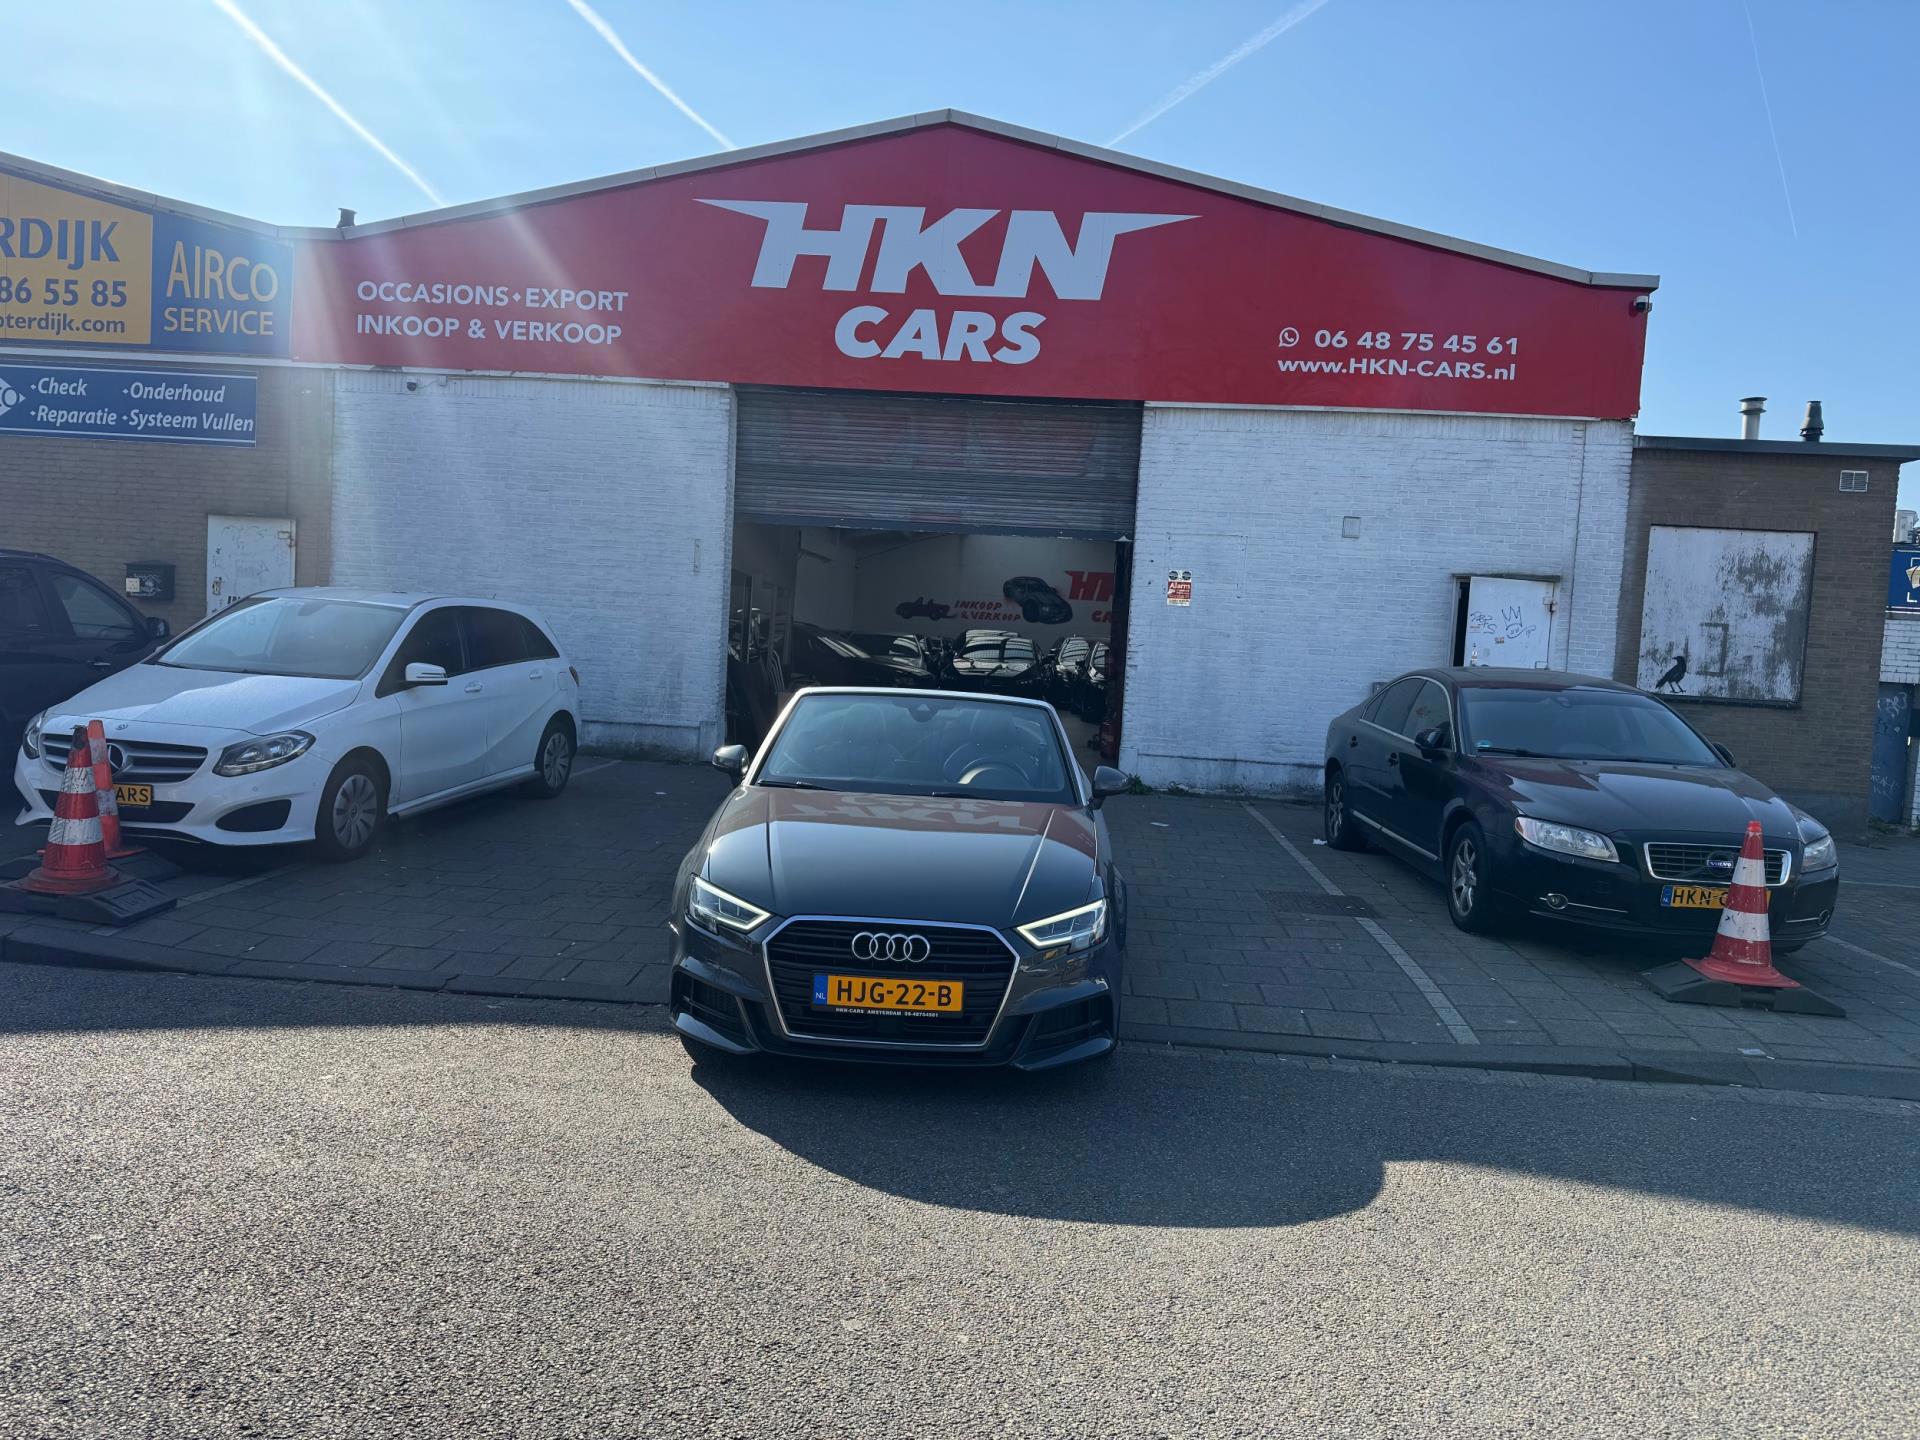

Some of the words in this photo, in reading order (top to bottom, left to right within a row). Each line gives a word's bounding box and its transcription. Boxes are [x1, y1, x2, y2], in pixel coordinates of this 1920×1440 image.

[693, 198, 1203, 301] HKN
[166, 240, 278, 302] AIRCO
[0, 276, 32, 304] 86
[43, 278, 79, 306] 55
[91, 279, 127, 307] 85
[357, 280, 509, 307] OCCASIONS
[525, 287, 629, 312] EXPORT
[163, 307, 274, 336] SERVICE
[356, 314, 460, 337] INKOOP
[467, 318, 486, 339] &
[494, 319, 623, 345] VERKOOP
[834, 305, 1047, 365] CARS
[1314, 329, 1348, 348] 06
[1356, 331, 1391, 350] 48
[1400, 332, 1434, 351] 75
[1443, 335, 1477, 353] 45
[1486, 336, 1518, 355] 61
[1277, 357, 1516, 380] www.HKN-CARS.nl
[37, 377, 88, 396] Check
[130, 381, 226, 403] Onderhoud
[36, 405, 117, 426] Reparatie
[128, 409, 197, 430] Systeem
[202, 412, 254, 432] Vullen
[954, 600, 1003, 610] INKOOP
[115, 786, 149, 802] ARS
[1672, 888, 1728, 905] HKN-C
[815, 992, 826, 1000] NL
[837, 980, 952, 1007] HJG-22-B
